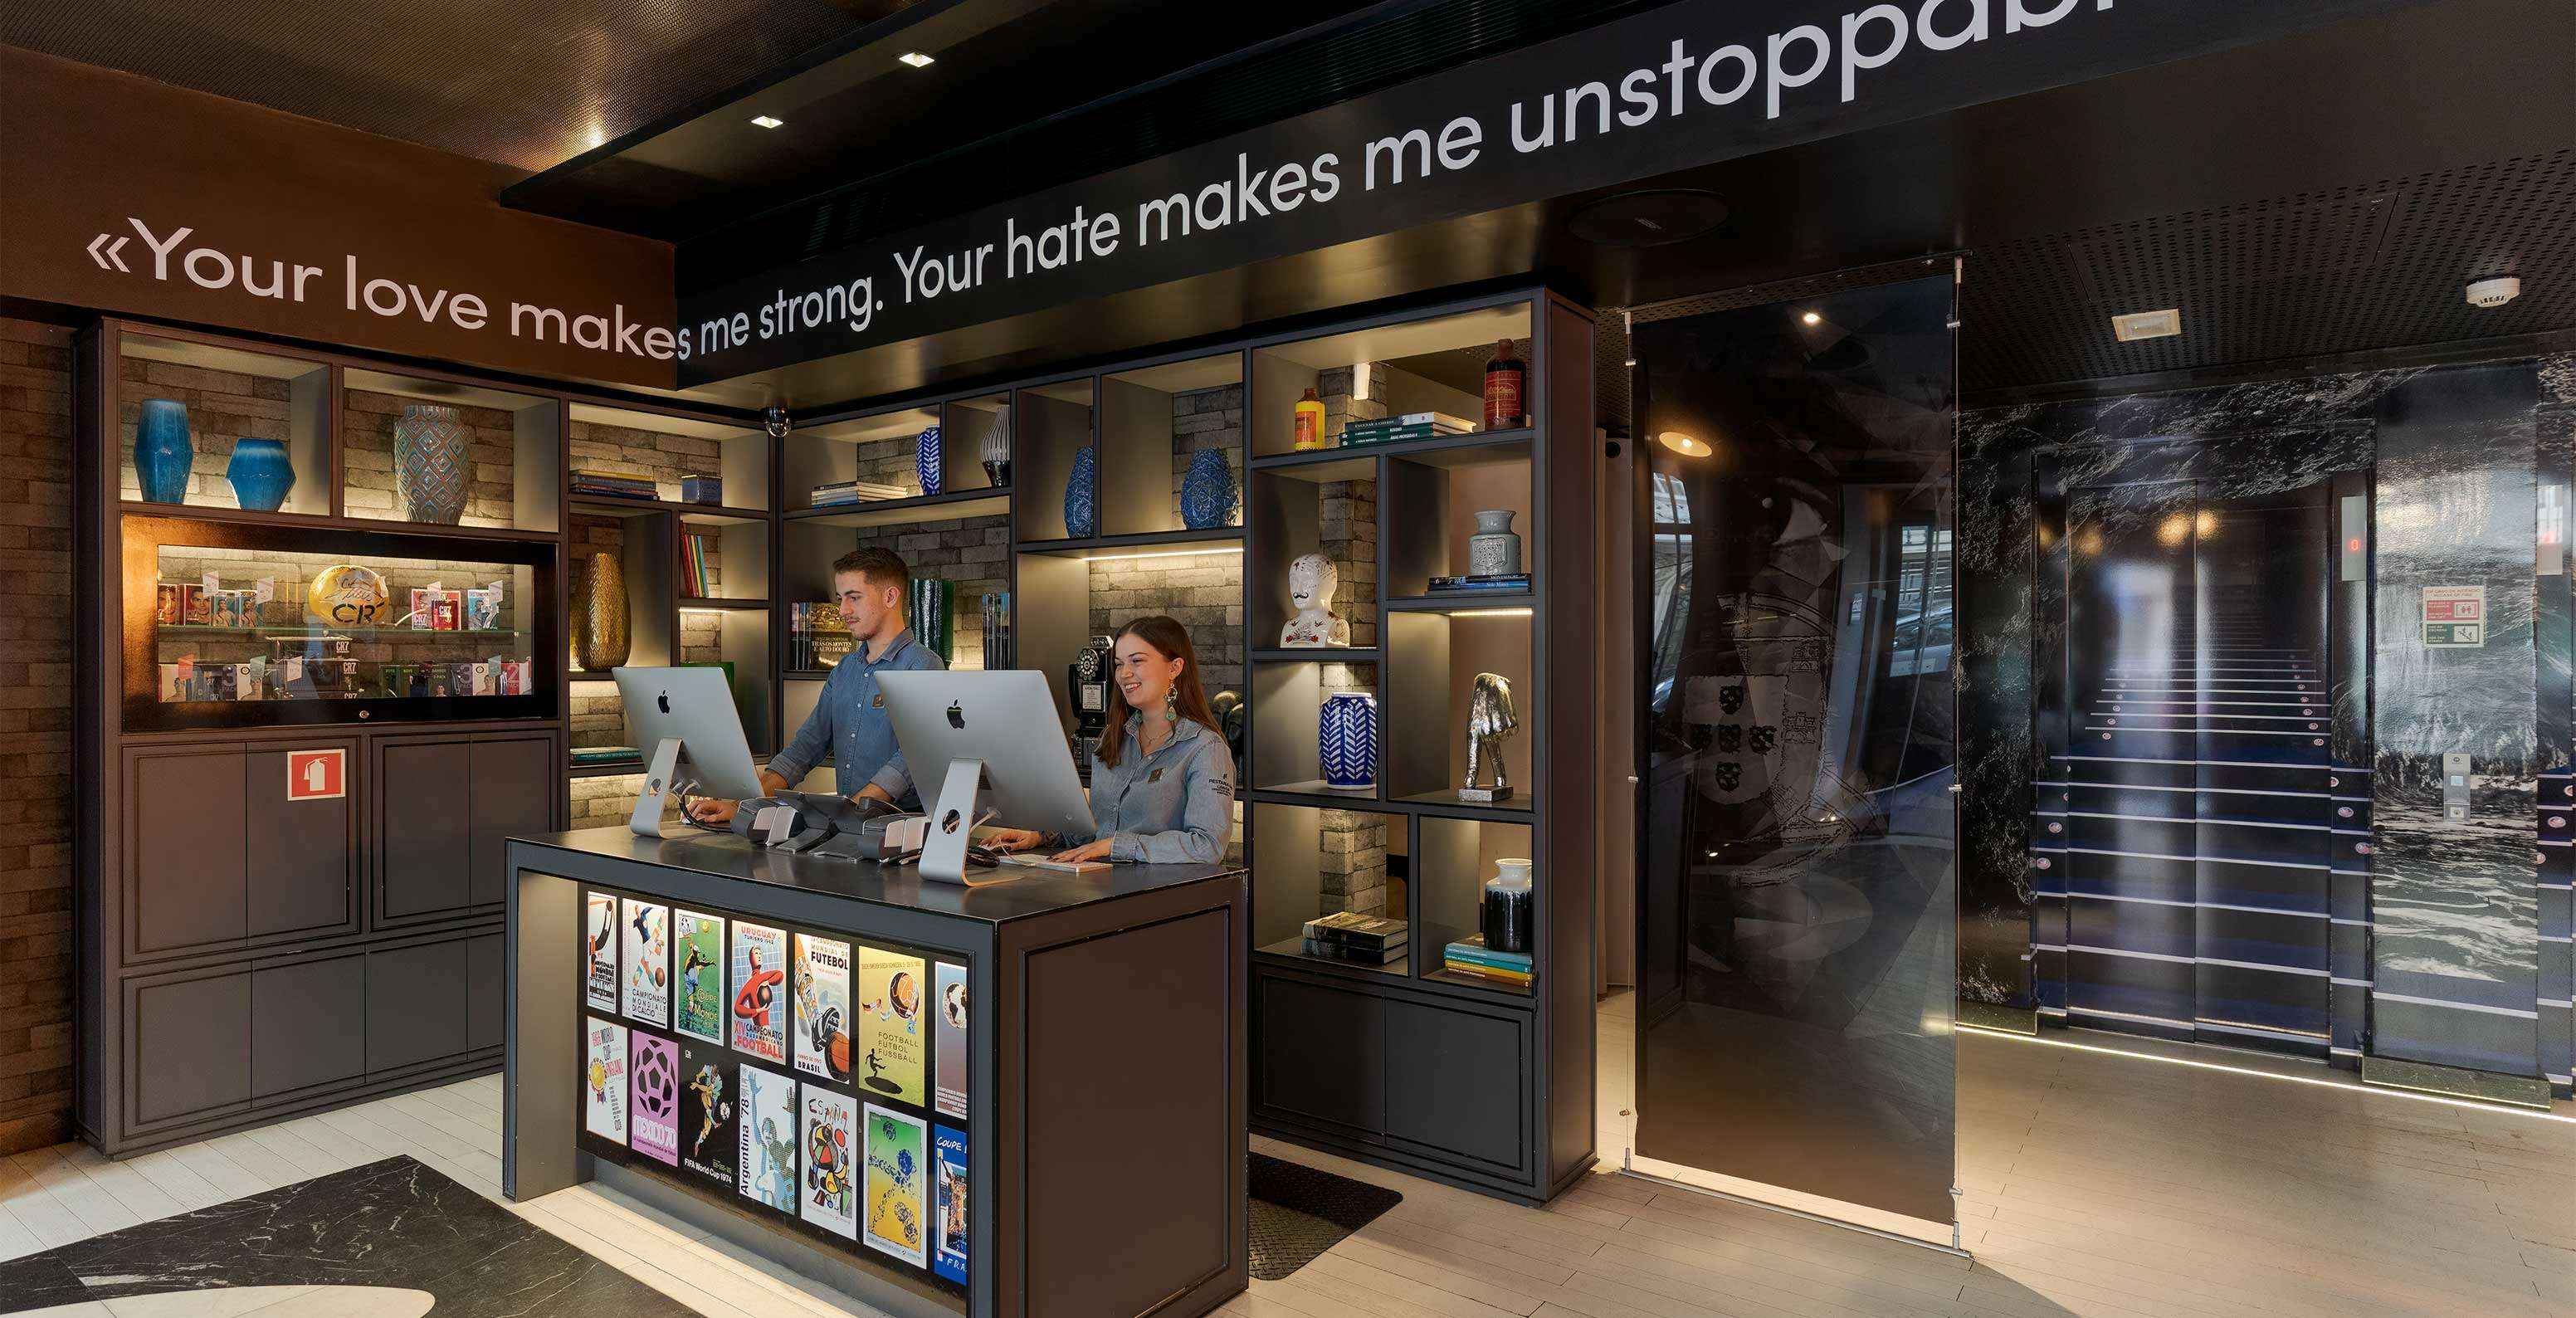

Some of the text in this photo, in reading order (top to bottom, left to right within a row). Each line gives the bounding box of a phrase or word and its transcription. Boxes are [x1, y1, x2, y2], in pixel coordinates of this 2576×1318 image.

[87, 0, 2114, 360] «Your love makes me strong. Your hate makes me unstoppa
[413, 613, 427, 623] CR7
[336, 641, 349, 651] CR7
[343, 662, 356, 672] CR7
[741, 926, 777, 940] URUGUAY
[811, 952, 848, 970] FUTEBOL
[632, 988, 667, 1004] CAMPIONATO
[632, 998, 666, 1013] MONDIALE
[637, 1006, 656, 1018] CALCIO
[734, 1020, 783, 1041] XIV CAMPEONATO
[878, 1032, 919, 1047] FOOTBALL
[878, 1040, 908, 1054] FUTBOL
[737, 1036, 783, 1060] FOOTBALL
[878, 1048, 918, 1064] FUSSBALL
[798, 1061, 821, 1073] BRASIL
[740, 1099, 750, 1119] '78
[936, 1136, 962, 1152] COUPE
[740, 1124, 751, 1194] Argentina
[684, 1158, 696, 1169] FIFA
[695, 1163, 710, 1176] World
[710, 1167, 720, 1180] Cup
[720, 1171, 732, 1184] 1974
[946, 1255, 968, 1272] FRA
